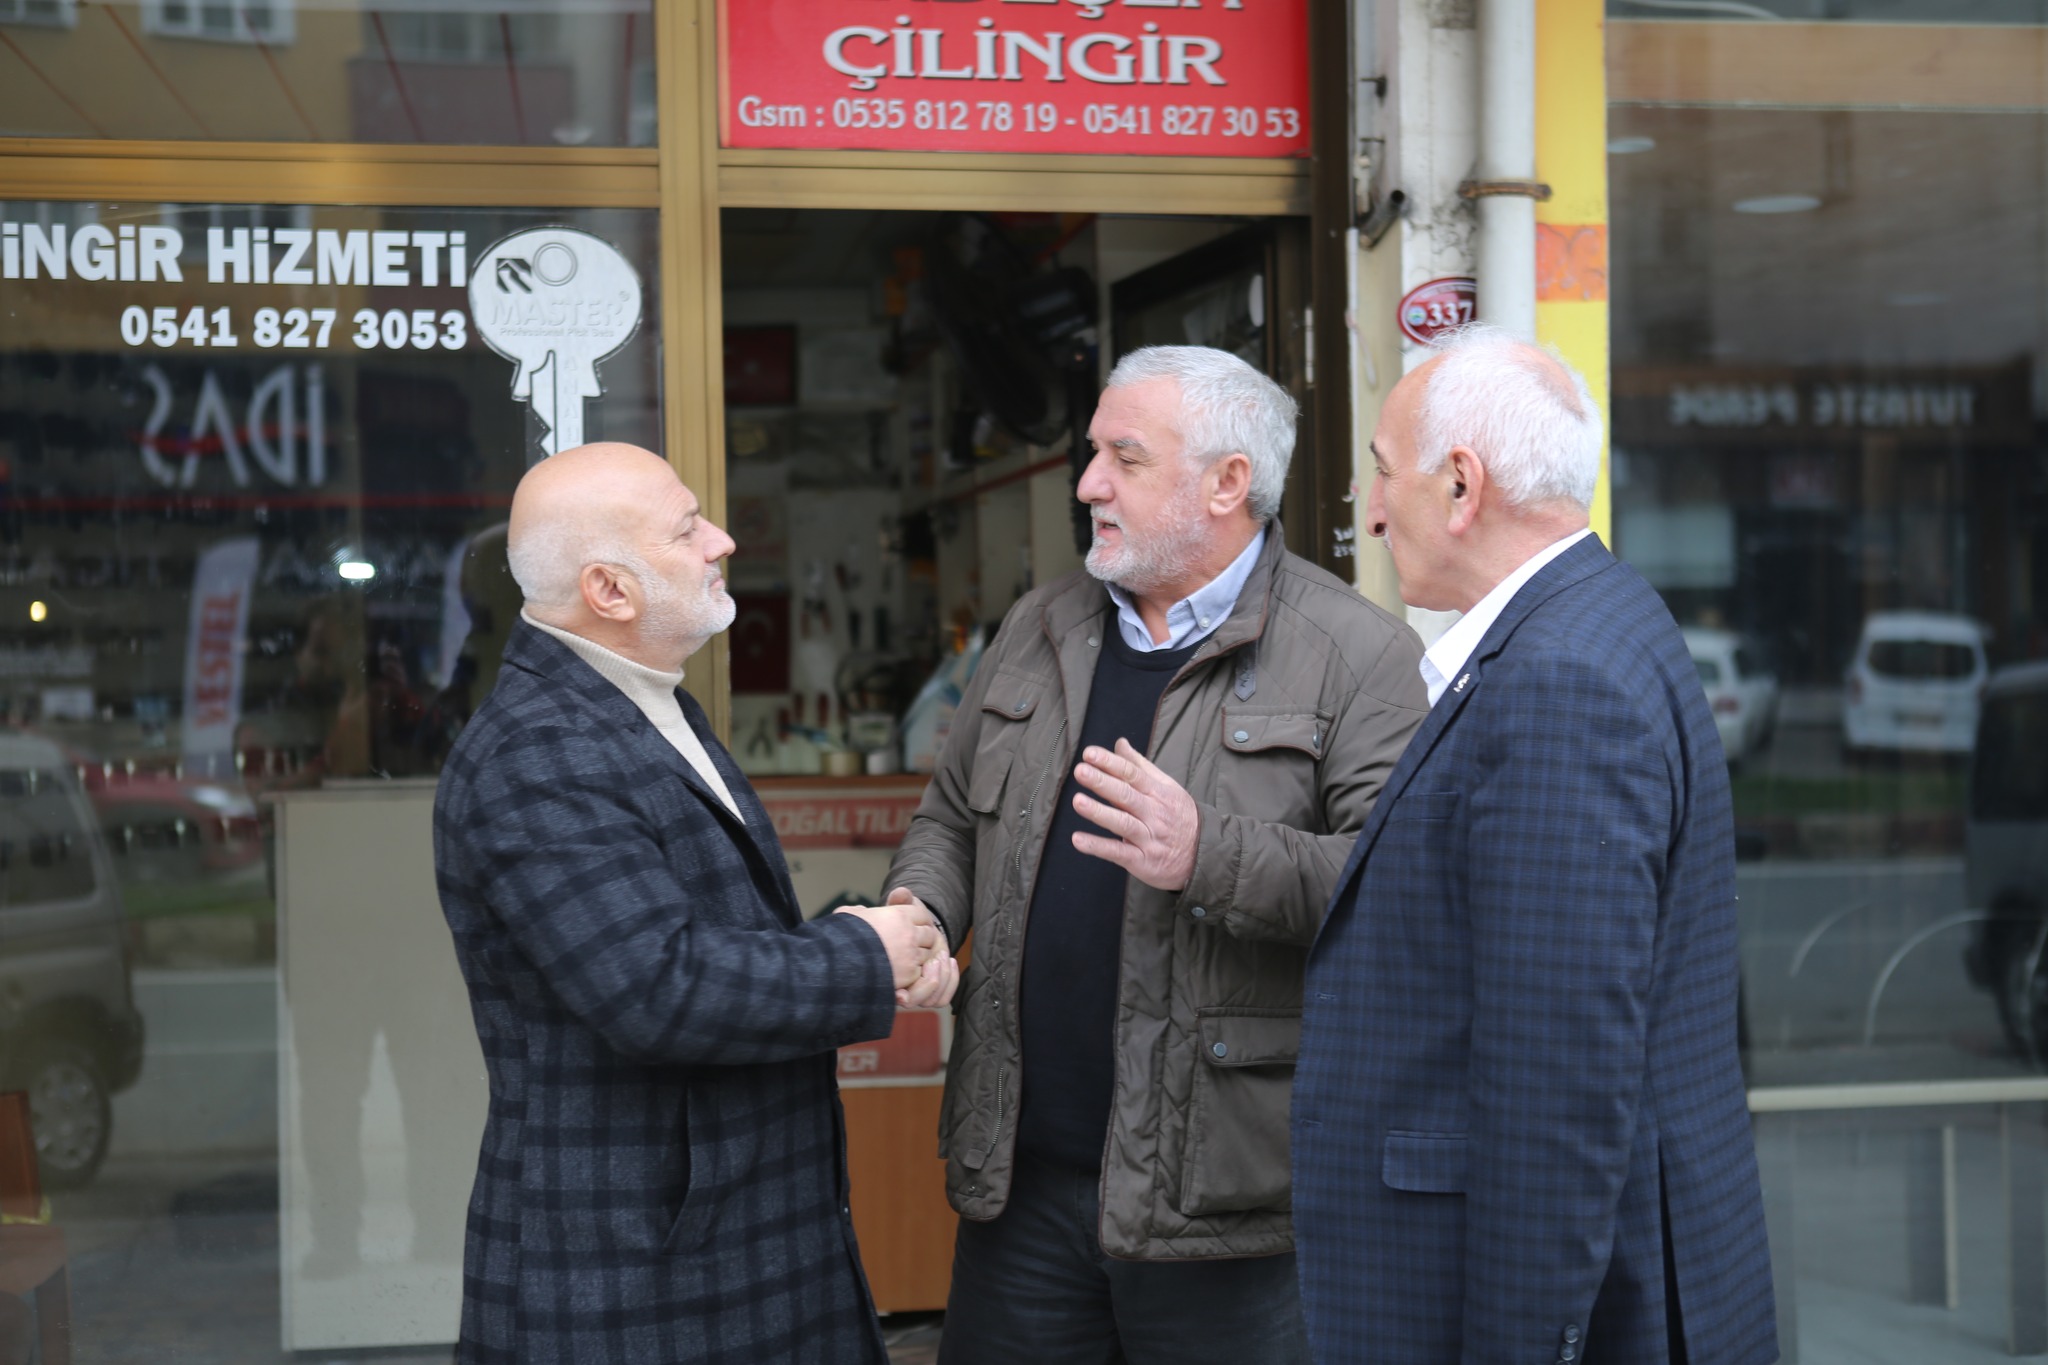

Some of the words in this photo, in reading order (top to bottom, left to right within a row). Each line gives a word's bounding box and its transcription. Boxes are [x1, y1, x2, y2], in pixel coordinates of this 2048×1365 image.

[823, 15, 1228, 91] ÇİLİNGİR
[738, 95, 807, 128] Gsm
[832, 97, 906, 129] 0535
[914, 99, 969, 131] 812
[976, 101, 1014, 132] 78
[1022, 102, 1058, 133] 19
[1083, 103, 1152, 135] 0541
[1161, 105, 1215, 136] 827
[1221, 106, 1259, 137] 30
[1264, 107, 1300, 138] 53
[120, 305, 238, 348] 0541
[253, 307, 337, 349] 827
[352, 308, 468, 350] 3053
[490, 299, 624, 327] MASTER
[1425, 300, 1474, 327] 337
[500, 327, 564, 338] Professional
